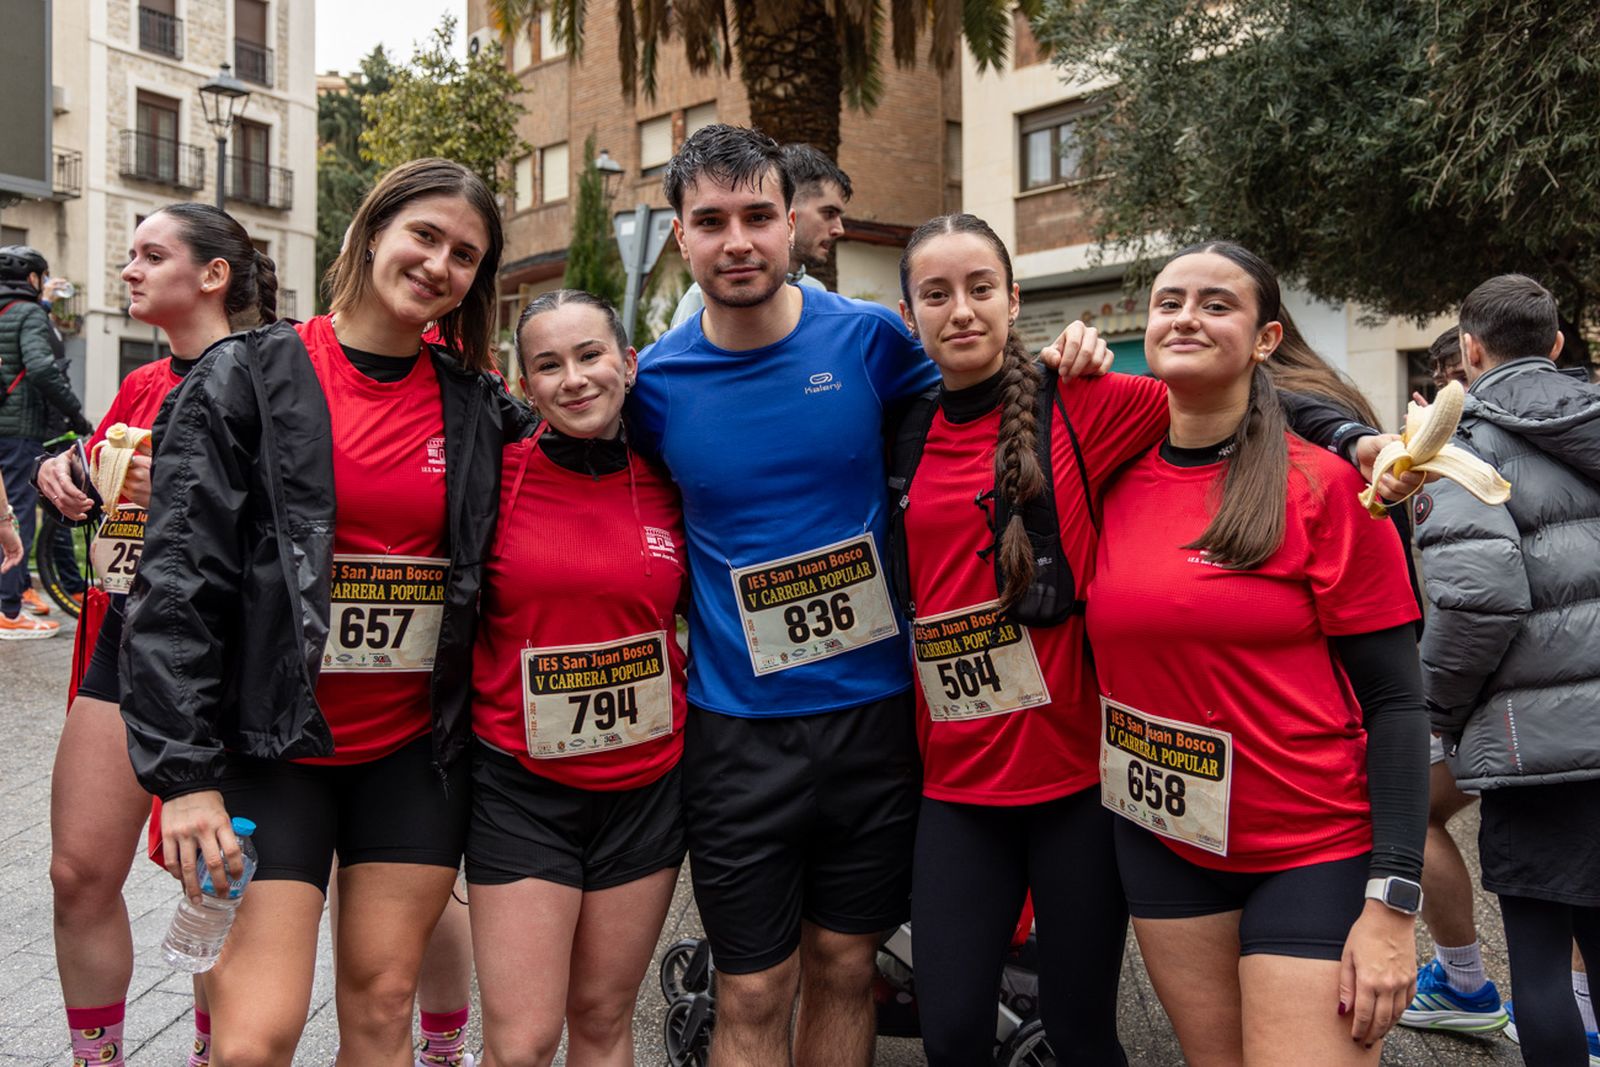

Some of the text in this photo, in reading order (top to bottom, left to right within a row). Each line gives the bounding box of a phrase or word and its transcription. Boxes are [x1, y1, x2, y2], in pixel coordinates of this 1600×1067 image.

[108, 523, 144, 538] CARRERA
[341, 565, 367, 579] San
[370, 566, 403, 581] Juan
[406, 566, 443, 580] Bosco
[748, 548, 863, 590] IES San Juan Bosco
[748, 561, 872, 608] V CARRERA POPULAR
[390, 584, 445, 600] POPULAR
[339, 607, 415, 649] 657
[784, 592, 855, 644] 836
[941, 620, 969, 637] Juan
[538, 643, 654, 672] IES San Juan Bosco
[921, 639, 962, 658] CARRERA
[535, 658, 660, 690] V CARRERA POPULAR
[568, 686, 638, 735] 794
[1109, 725, 1219, 778] V CARRERA POPULAR
[1111, 710, 1215, 754] IES San Juan Bosco
[1127, 760, 1186, 818] 658
